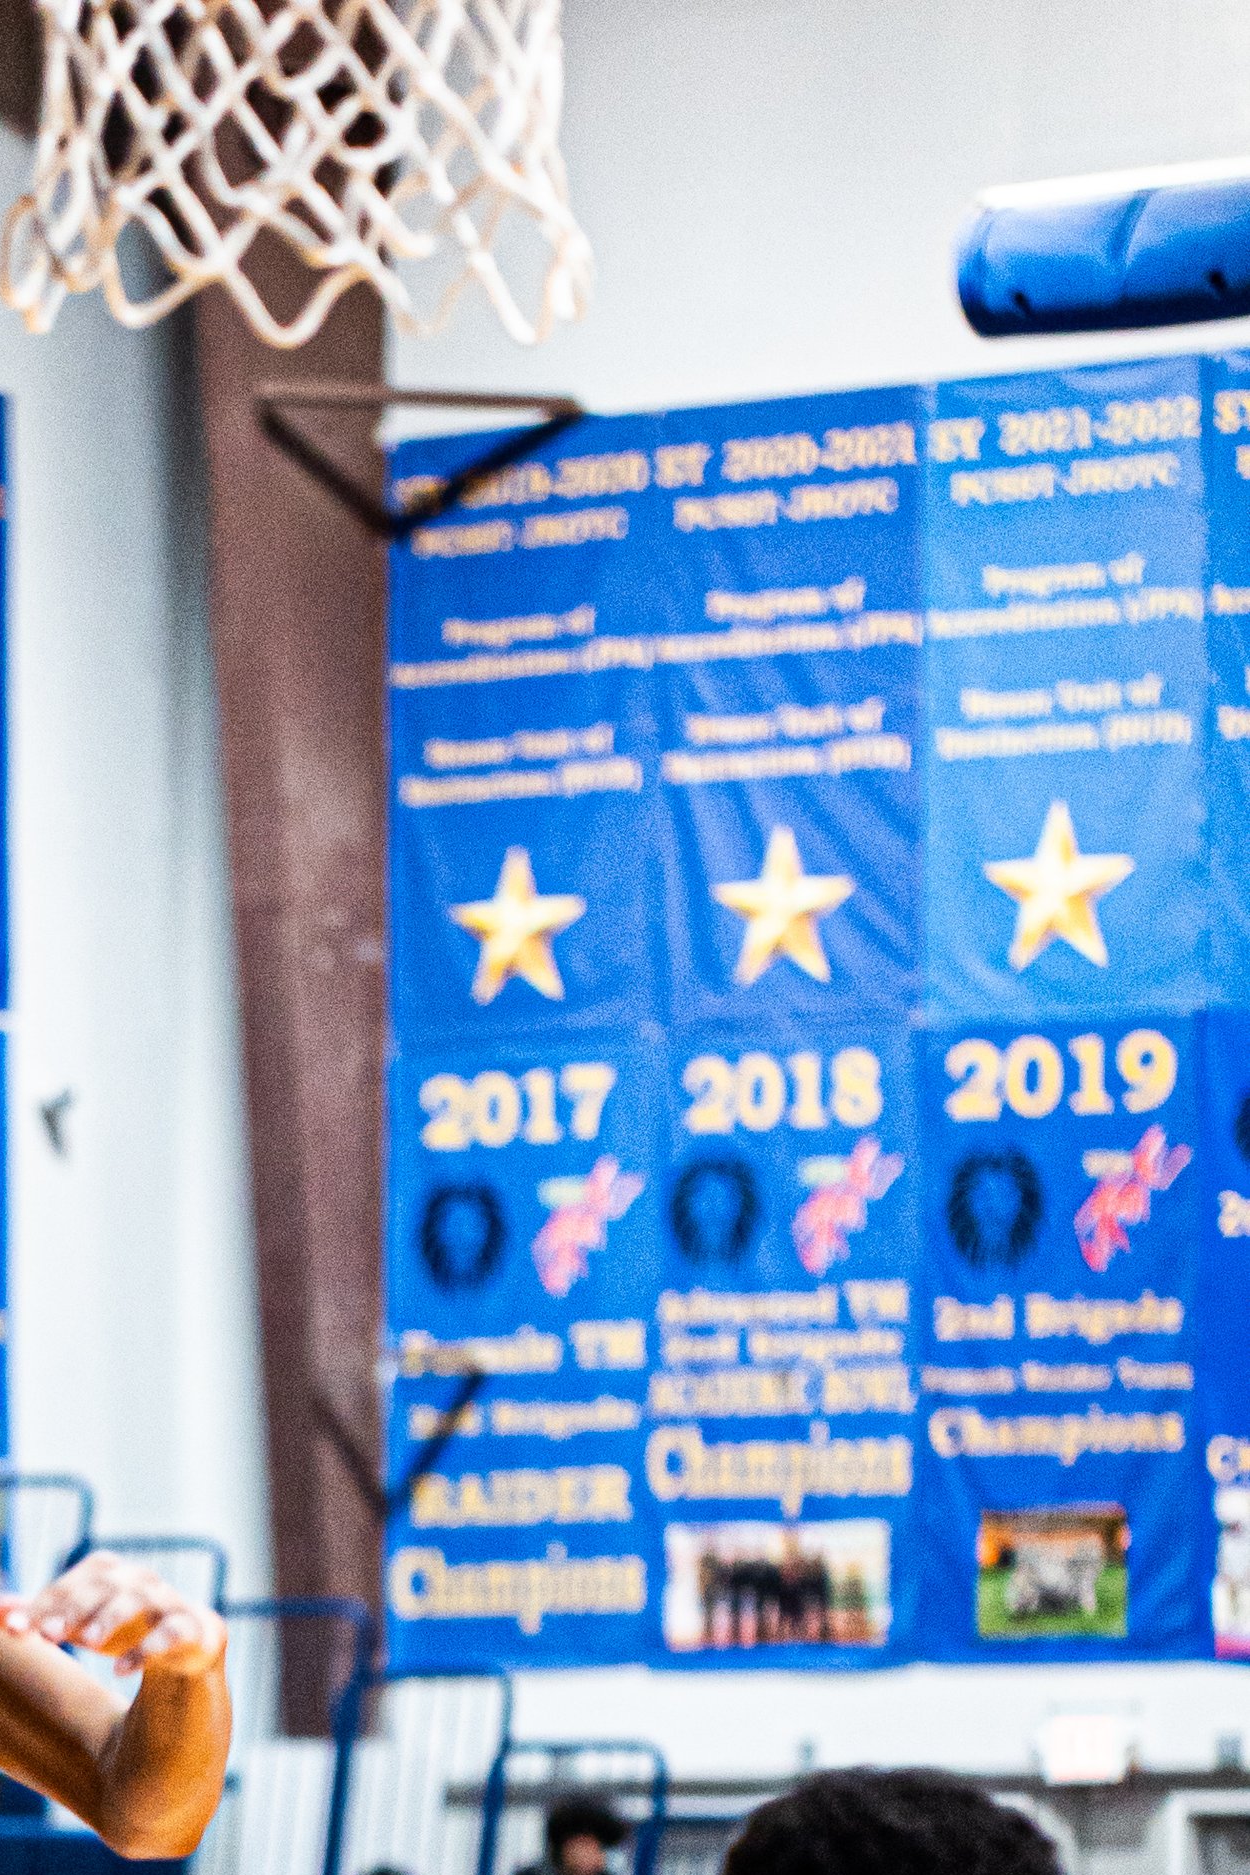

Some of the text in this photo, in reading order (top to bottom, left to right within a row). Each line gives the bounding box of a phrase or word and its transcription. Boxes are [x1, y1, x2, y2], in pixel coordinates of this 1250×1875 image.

[721, 422, 917, 482] 2020-2021
[999, 396, 1202, 457] 2021-2022
[420, 1061, 617, 1150] 2017
[682, 1047, 882, 1134] 2018
[944, 1028, 1178, 1122] 2019
[934, 1294, 1015, 1342] 2nd
[1025, 1289, 1184, 1345] Brigade
[645, 1421, 913, 1518] Champions
[928, 1403, 1186, 1467] Champions
[388, 1541, 648, 1636] Champions
